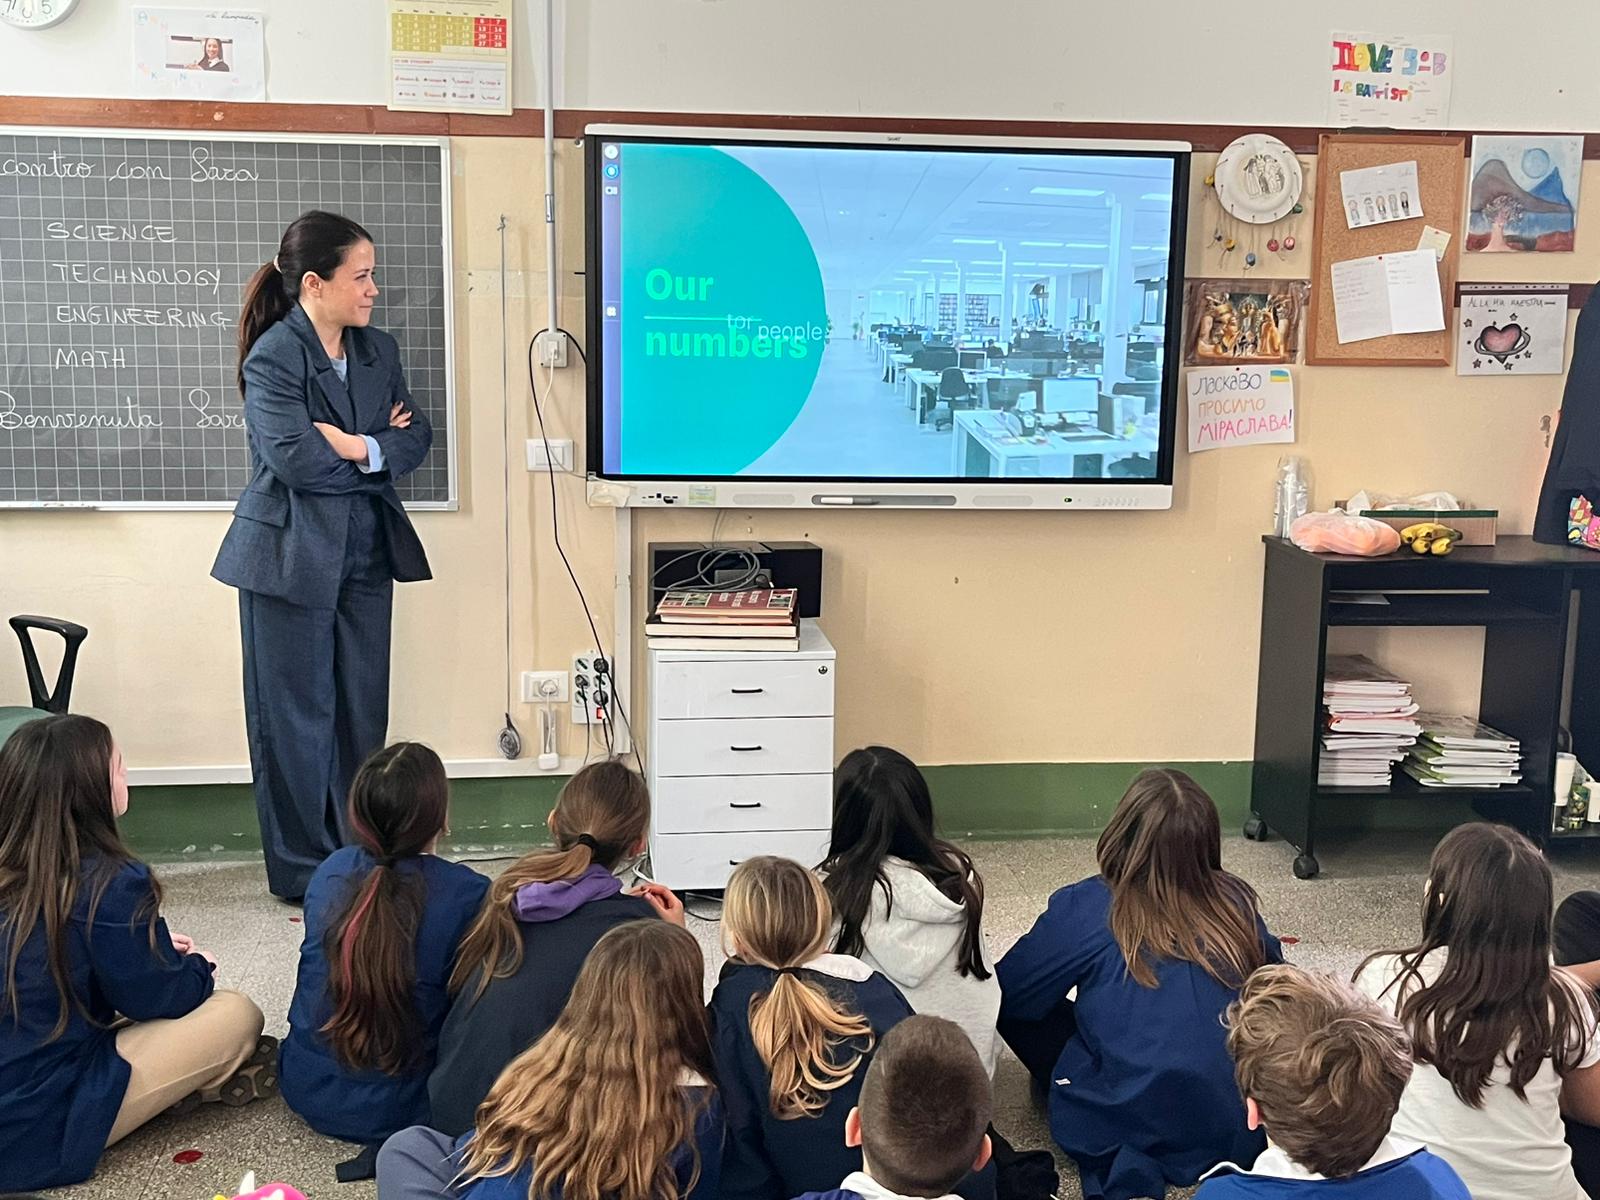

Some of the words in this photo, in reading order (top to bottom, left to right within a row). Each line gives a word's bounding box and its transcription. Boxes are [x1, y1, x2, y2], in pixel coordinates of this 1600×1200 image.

[109, 161, 171, 182] con
[190, 146, 259, 182] Sara
[46, 221, 178, 243] SCIENCE
[52, 263, 221, 295] TECHNOLOGY
[645, 268, 714, 301] Our
[56, 305, 232, 331] ENGINEERING
[645, 324, 808, 359] numbers
[55, 347, 126, 370] MATH
